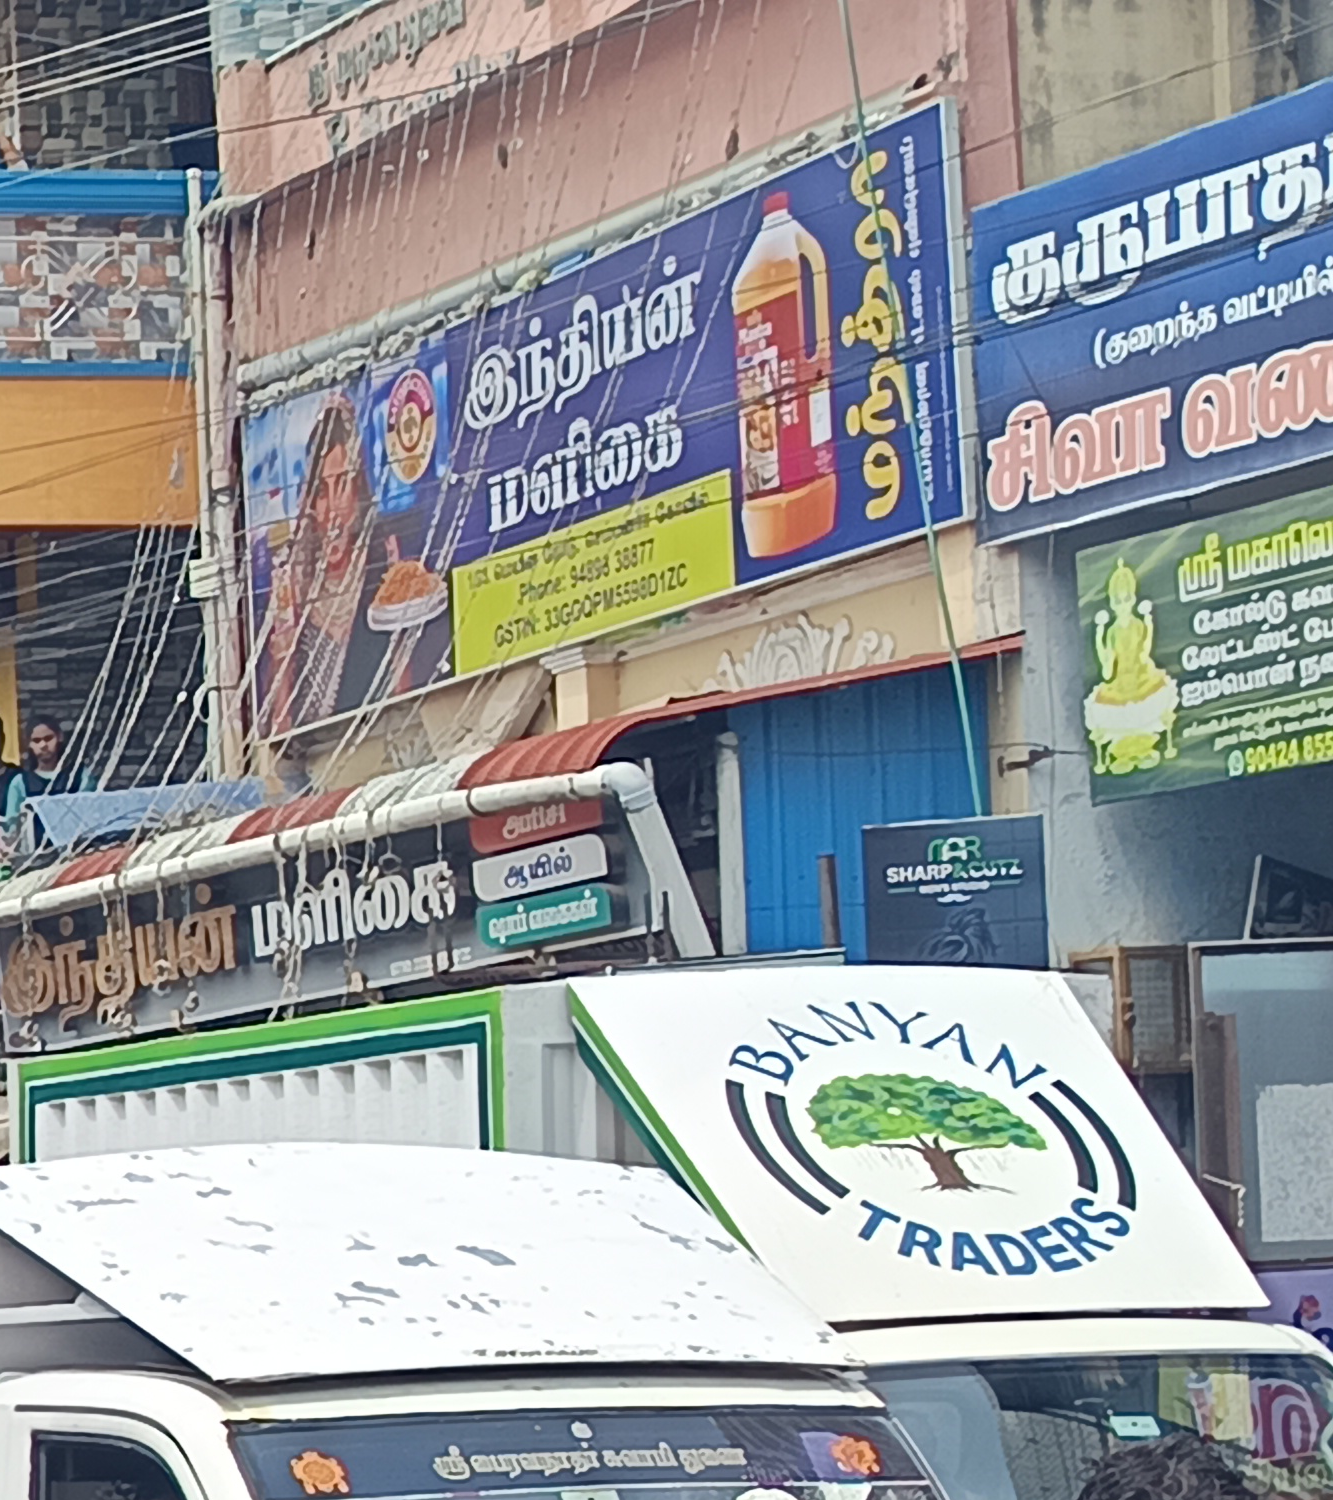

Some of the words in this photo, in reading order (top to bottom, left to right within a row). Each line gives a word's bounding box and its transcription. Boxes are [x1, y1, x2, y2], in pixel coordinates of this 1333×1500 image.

[463, 255, 701, 430] இந்தியன்
[487, 404, 683, 532] மளிகை
[987, 387, 1171, 512] சிவா
[504, 846, 573, 889] ஆயில்
[730, 1001, 1047, 1089] BANYAN
[855, 1198, 1132, 1276] TRADERS
